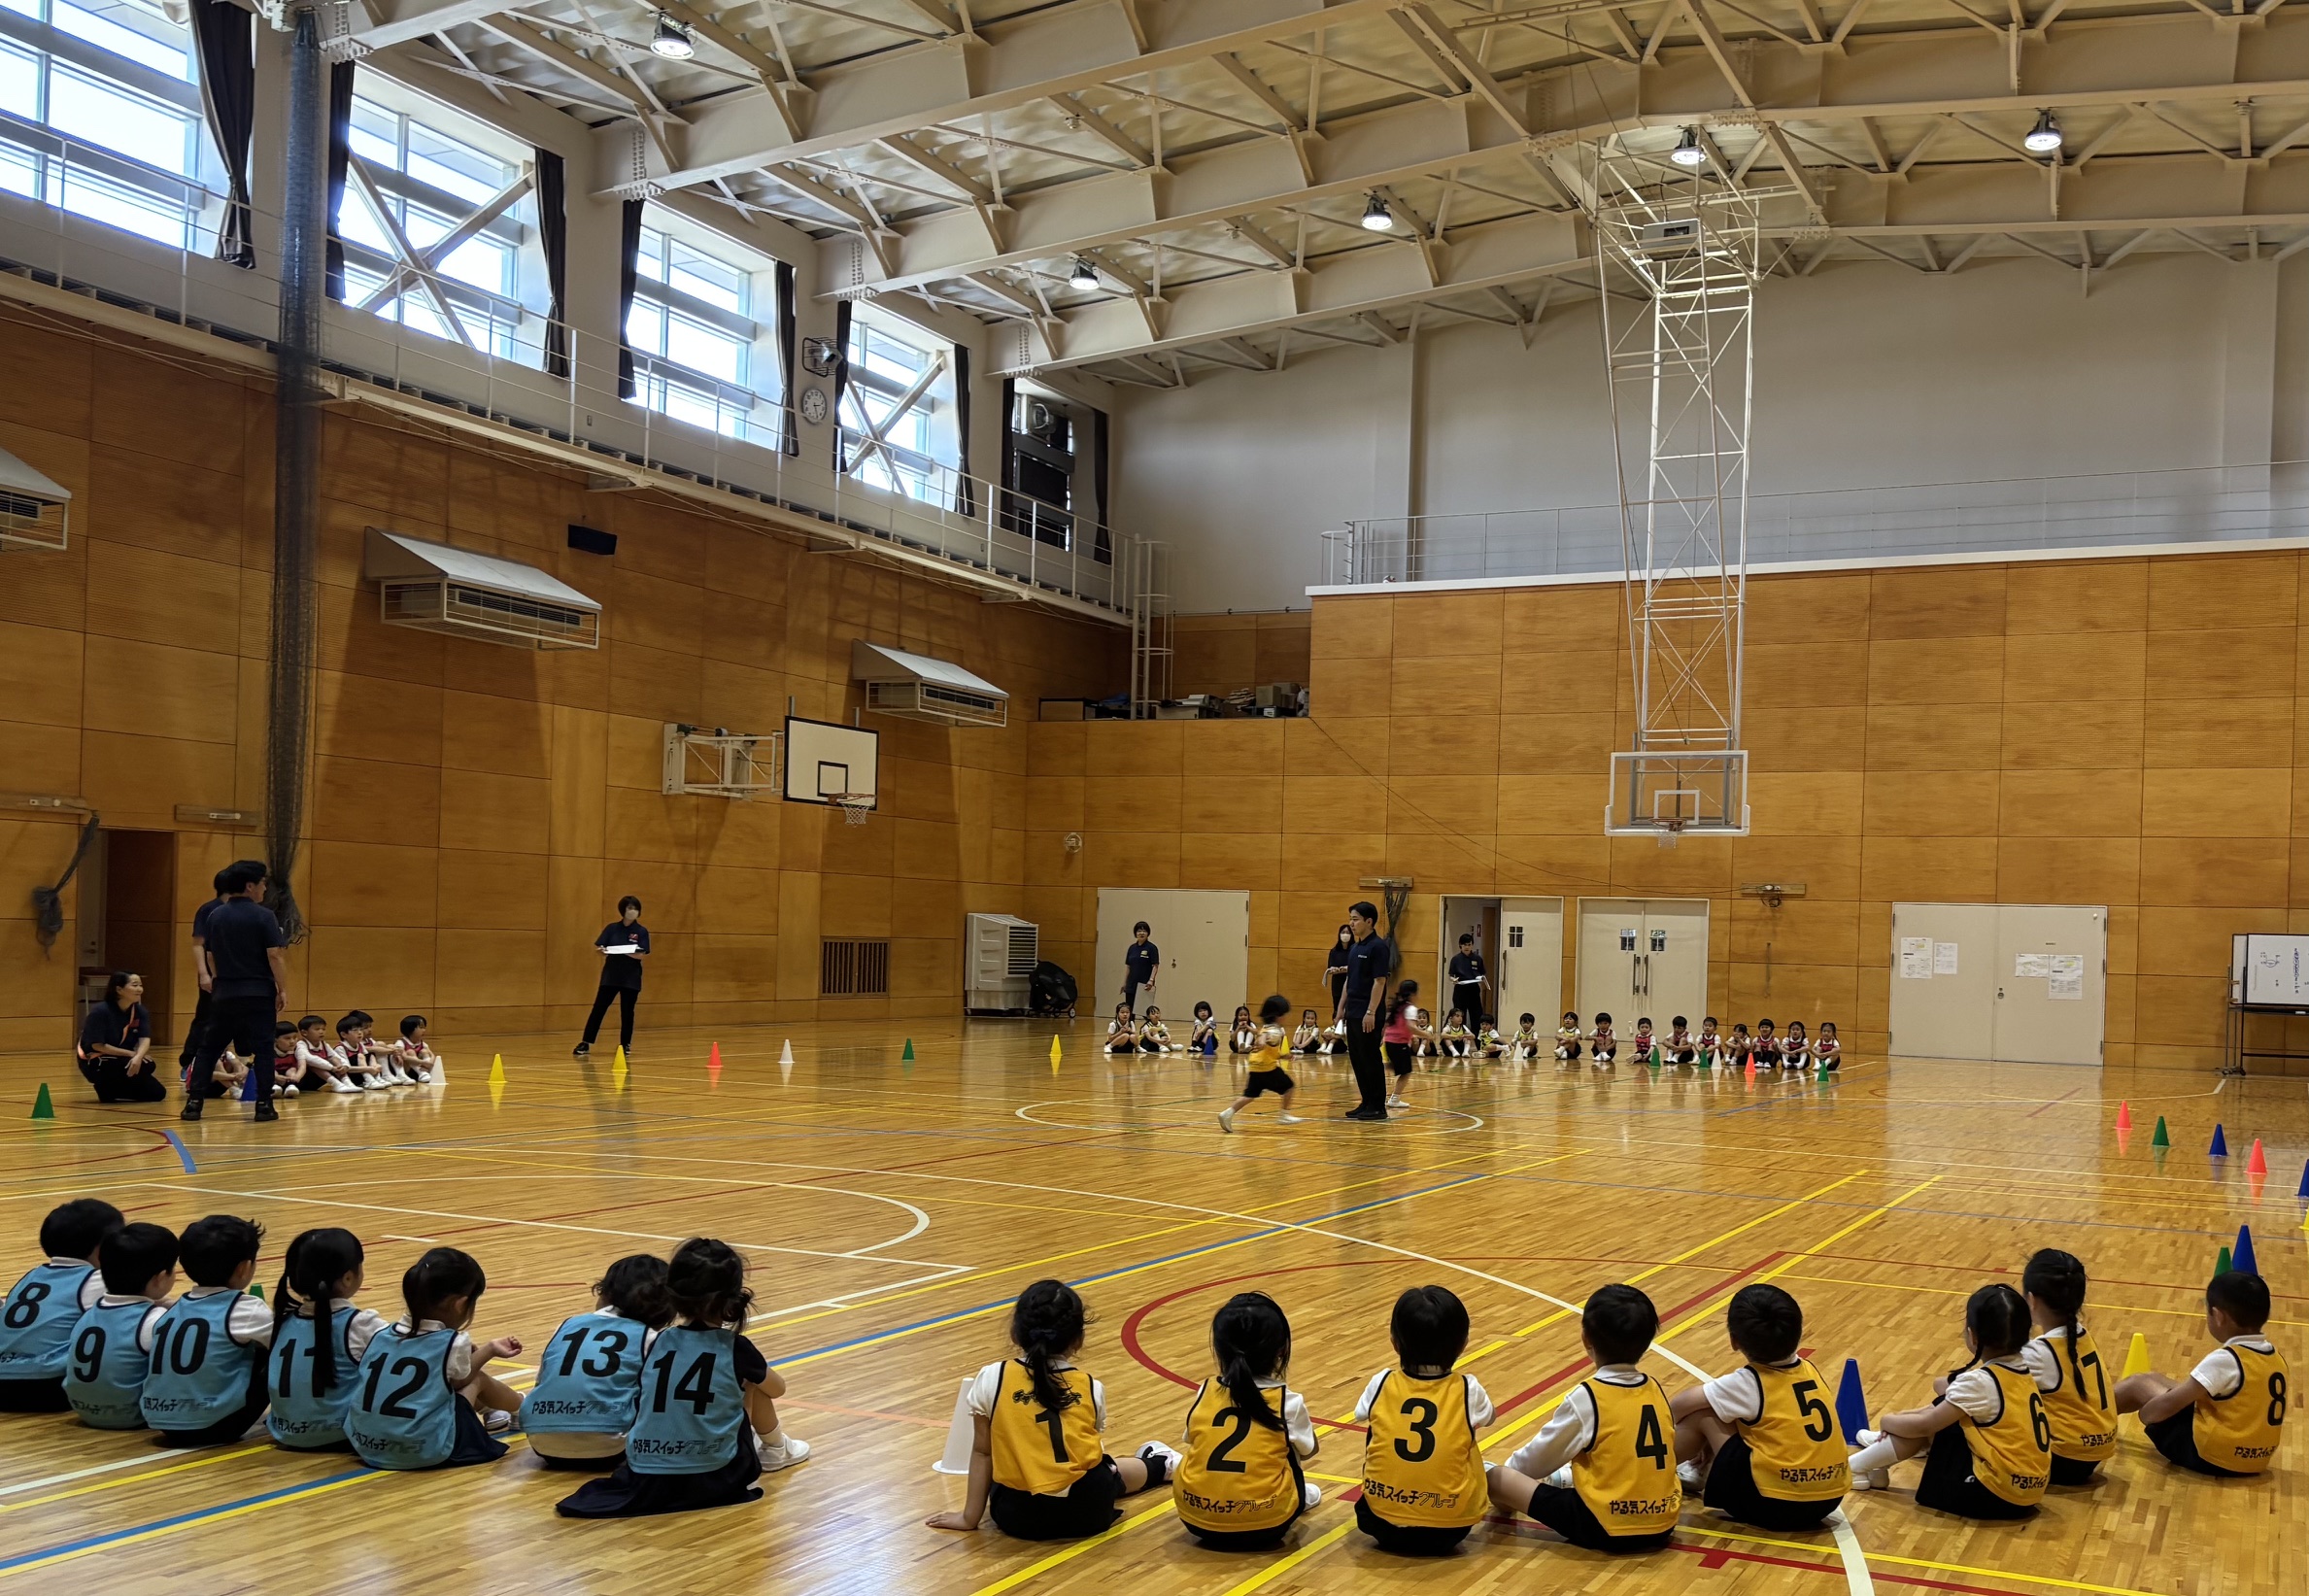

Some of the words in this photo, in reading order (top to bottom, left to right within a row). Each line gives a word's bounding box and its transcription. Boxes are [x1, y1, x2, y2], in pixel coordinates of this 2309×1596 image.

[4, 1281, 51, 1329] 8
[74, 1325, 106, 1383] 9
[152, 1317, 210, 1375] 10
[558, 1327, 628, 1377] 13
[361, 1351, 429, 1419] 12
[652, 1349, 717, 1415] 14
[2080, 1350, 2108, 1411] 7
[2267, 1371, 2286, 1427] 8
[1035, 1406, 1070, 1464] 1
[1205, 1406, 1252, 1474] 2
[1393, 1397, 1439, 1463] 3
[1635, 1403, 1668, 1471] 4
[1791, 1379, 1833, 1443] 5
[2028, 1391, 2050, 1453] 6
[1182, 1488, 1278, 1514] やる気スイッチグループ
[1364, 1477, 1461, 1509] やる気スイッチグループ
